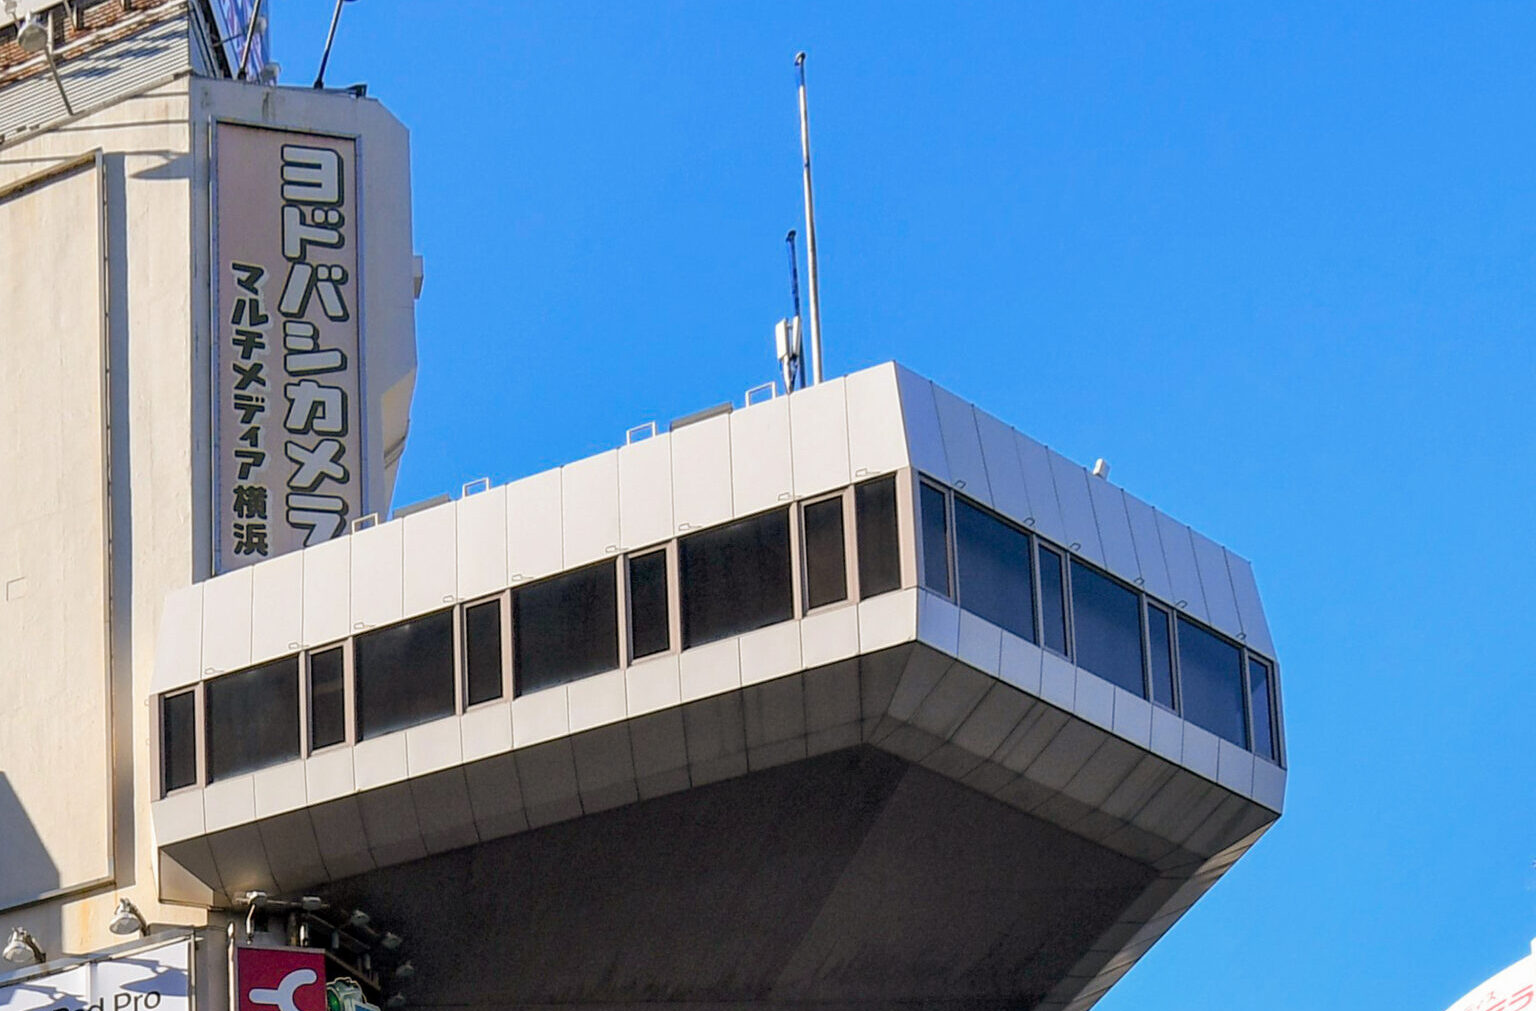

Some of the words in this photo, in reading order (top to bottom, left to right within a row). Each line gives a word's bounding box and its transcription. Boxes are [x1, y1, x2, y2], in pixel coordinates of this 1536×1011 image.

[230, 262, 269, 556] マルチメディア横浜
[280, 143, 350, 549] ヨドバシカメラ
